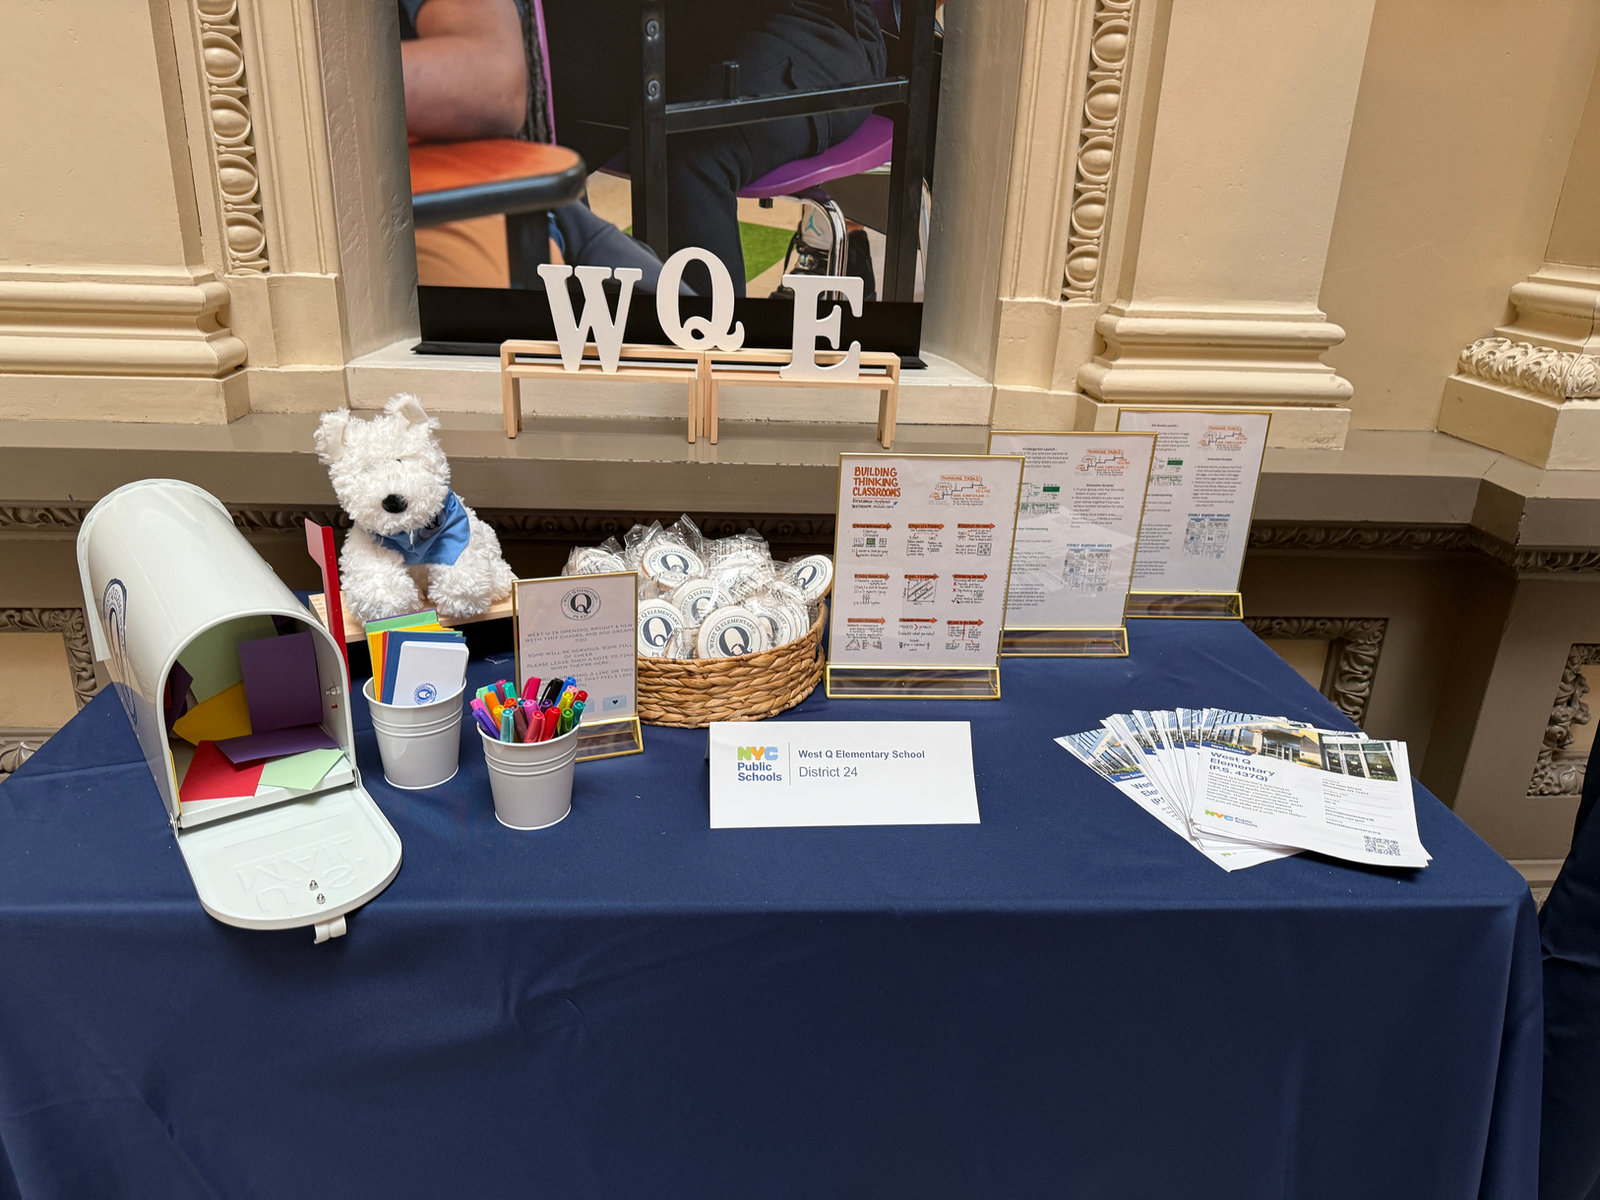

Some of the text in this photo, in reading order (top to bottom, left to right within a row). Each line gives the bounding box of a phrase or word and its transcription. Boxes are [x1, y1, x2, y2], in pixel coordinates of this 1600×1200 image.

[854, 466, 898, 477] BUILDING
[853, 477, 898, 487] THINKING
[852, 486, 901, 497] CLASSROOMS
[660, 553, 689, 575] Q
[570, 593, 592, 613] Q
[647, 609, 679, 625] ELEMENTARY
[721, 618, 755, 630] ELEMENTARY
[643, 616, 673, 647] Q
[719, 626, 753, 656] Q
[737, 746, 778, 760] NYC
[798, 750, 925, 761] West Q Elementary School
[1210, 751, 1240, 762] West
[738, 762, 772, 772] Public
[800, 766, 858, 777] District 24
[1210, 758, 1275, 776] Elementary
[738, 772, 782, 782] Schools
[1209, 765, 1268, 782] (P.S. 437Q)
[1205, 810, 1234, 821] NYC
